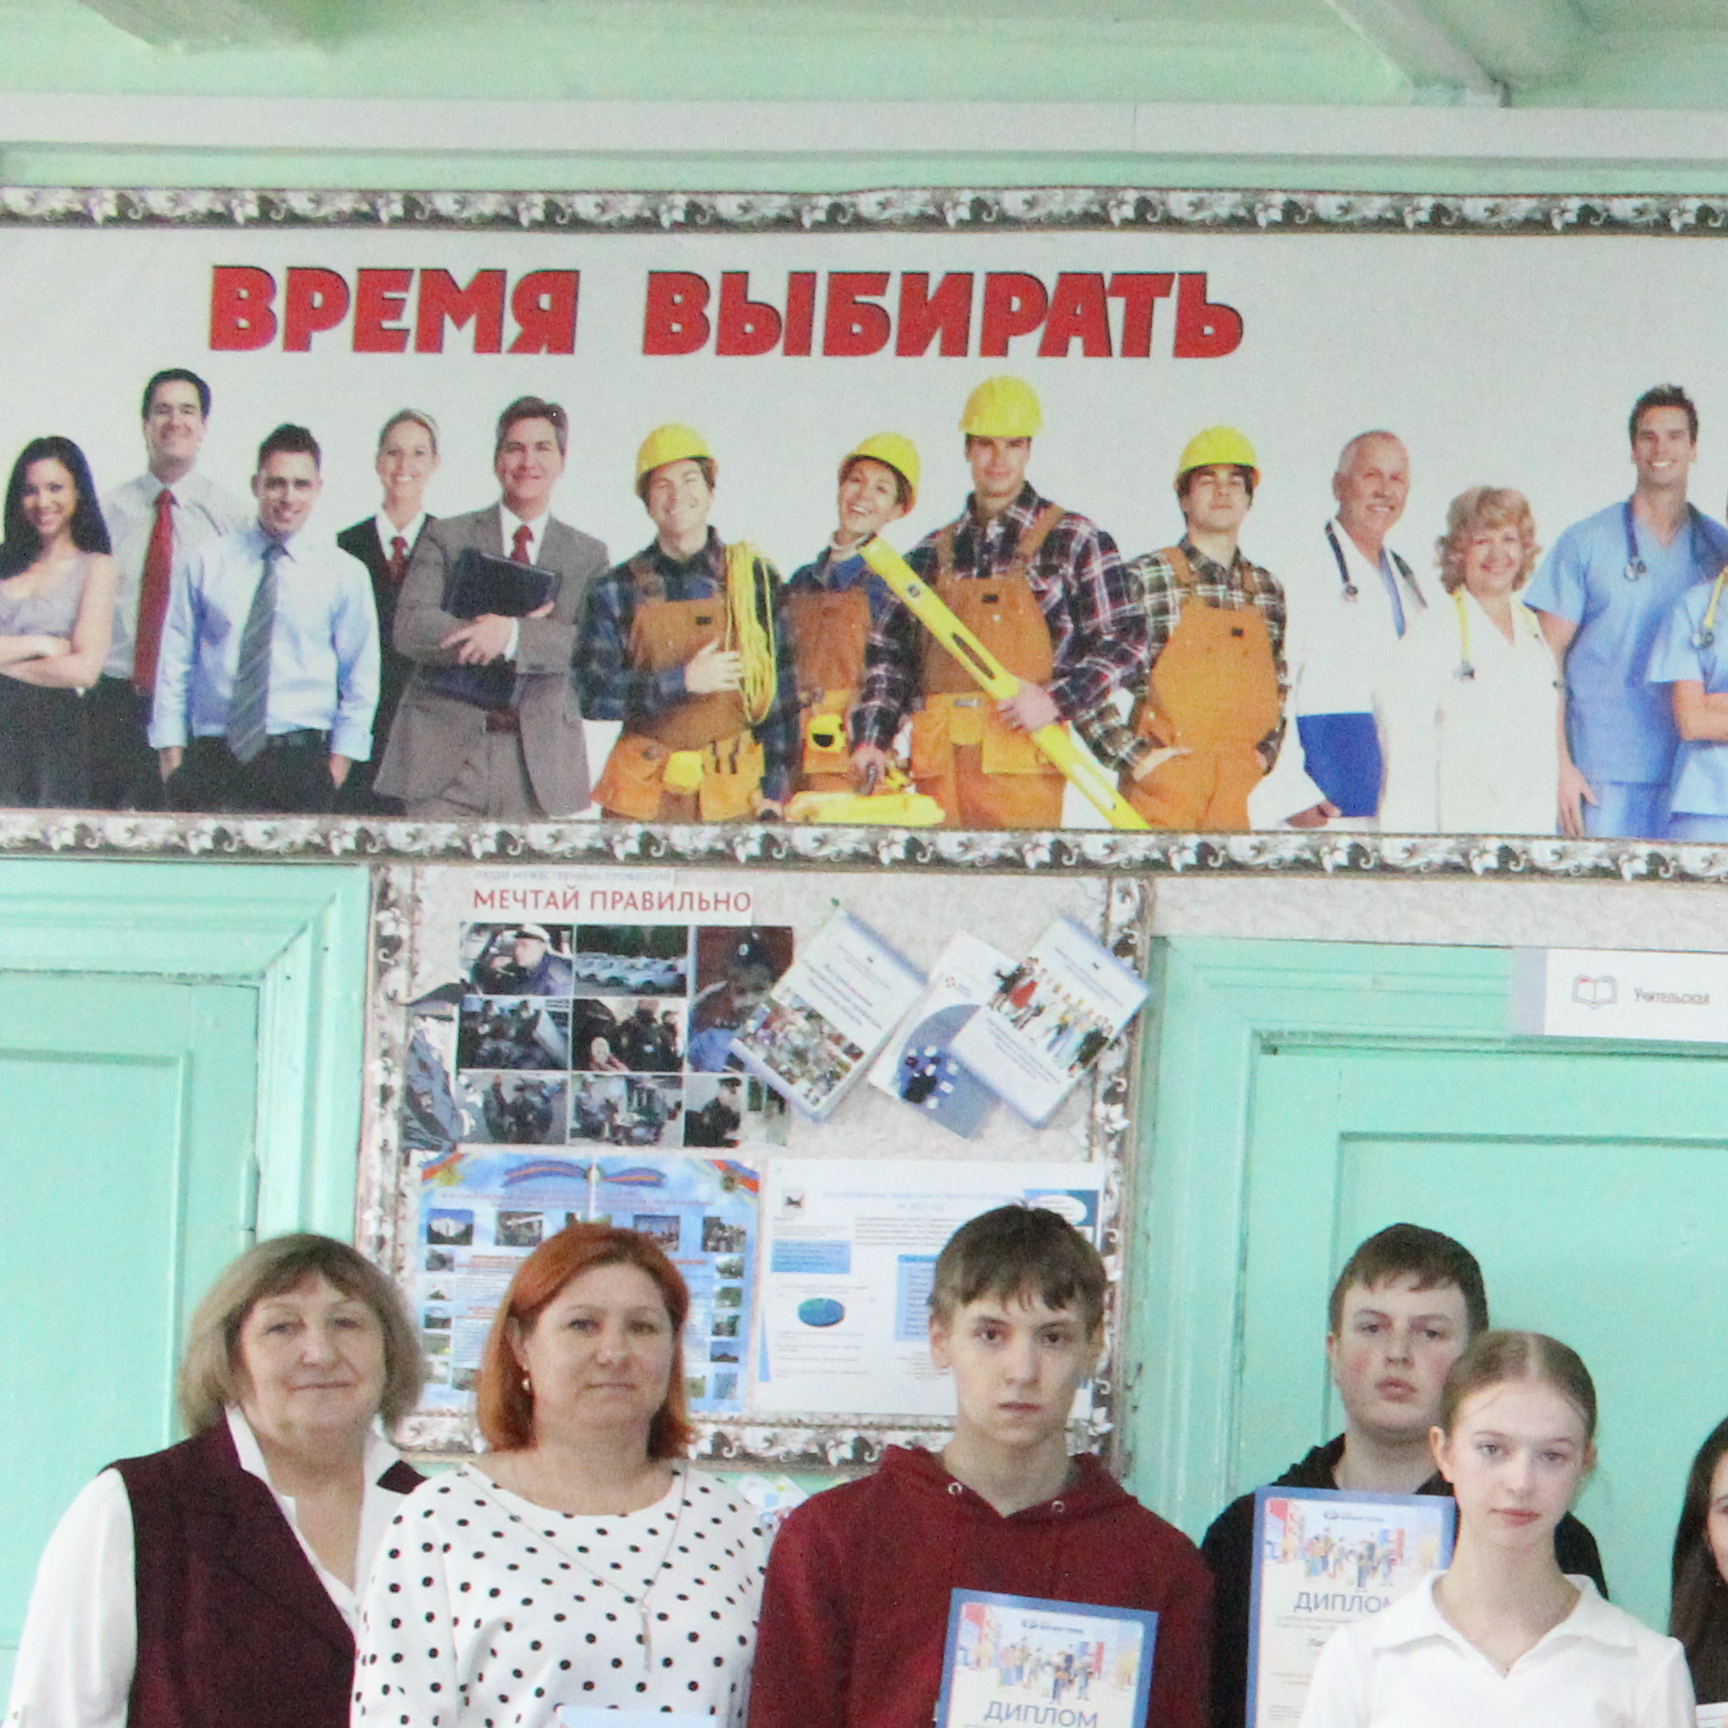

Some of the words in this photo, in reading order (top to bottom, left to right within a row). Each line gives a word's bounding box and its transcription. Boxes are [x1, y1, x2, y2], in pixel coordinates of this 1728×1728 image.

[209, 264, 580, 355] ВРЕМЯ
[642, 269, 1246, 359] ВЫБИРАТЬ
[473, 884, 579, 911] МЕЧТАЙ
[590, 890, 752, 913] ПРАВИЛЬНО
[1633, 986, 1711, 1006] Учительская
